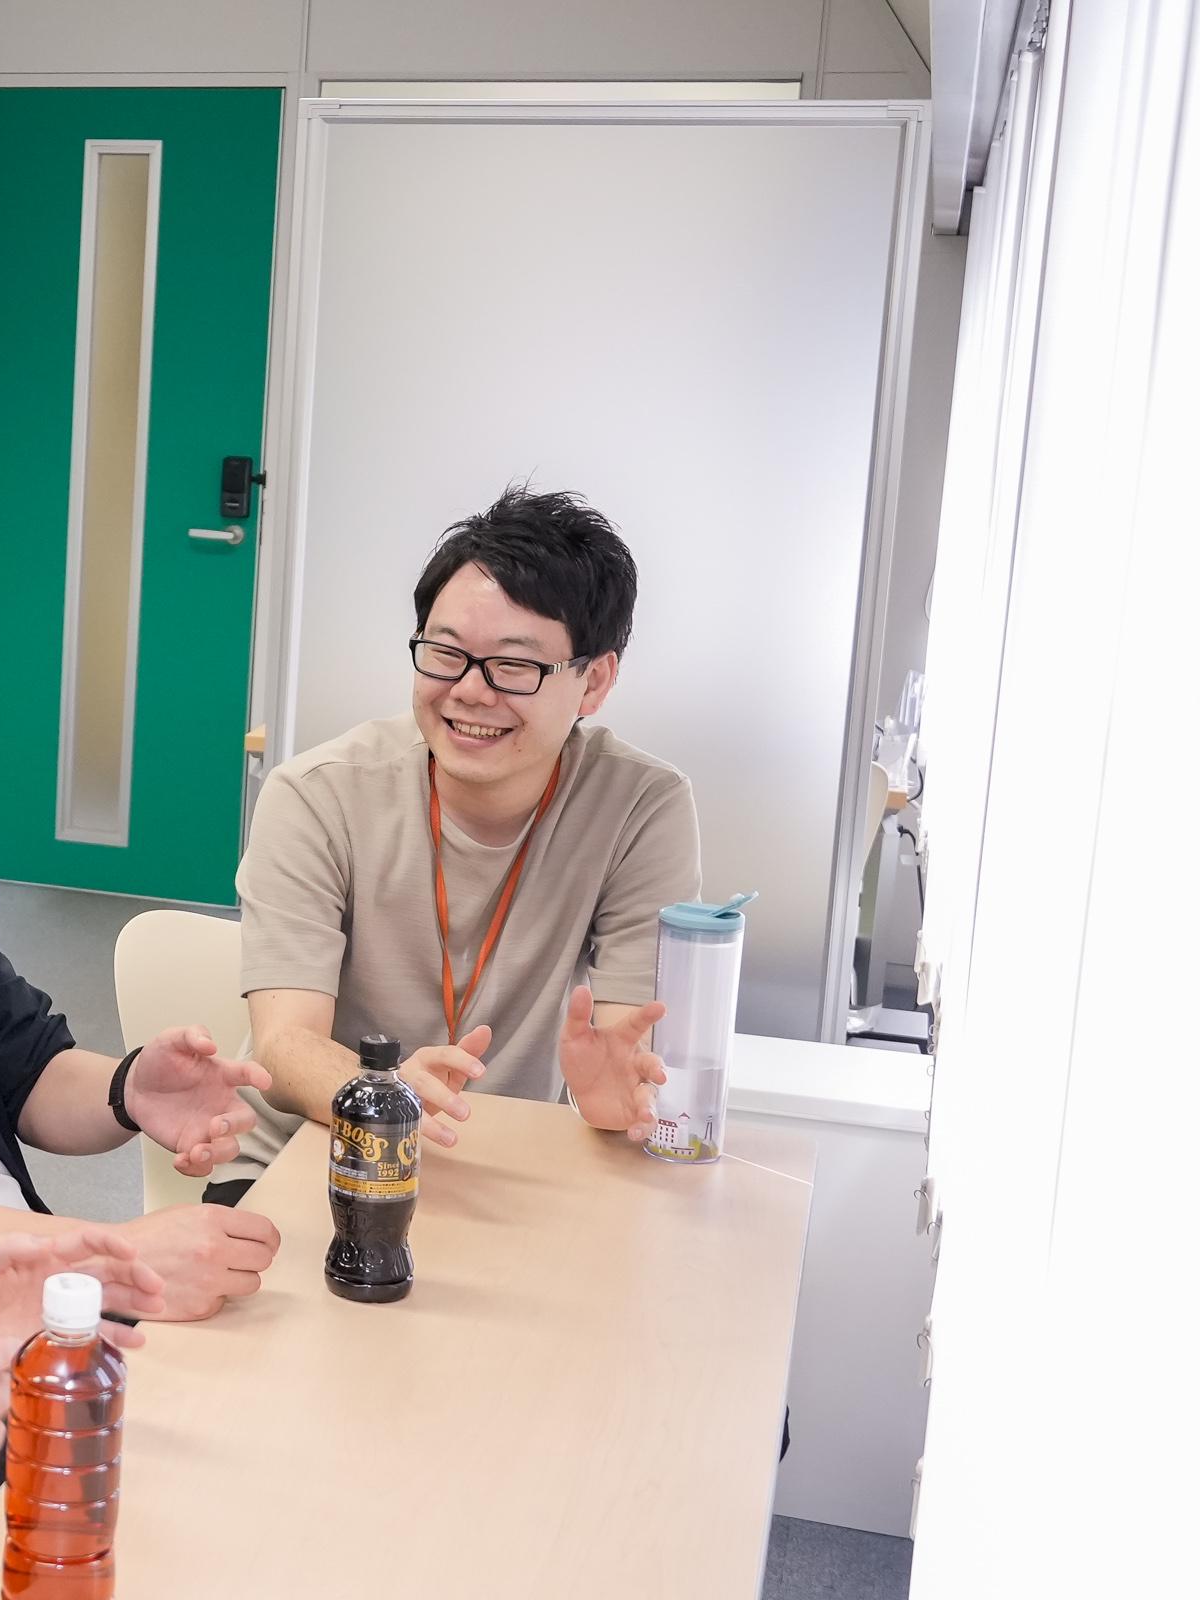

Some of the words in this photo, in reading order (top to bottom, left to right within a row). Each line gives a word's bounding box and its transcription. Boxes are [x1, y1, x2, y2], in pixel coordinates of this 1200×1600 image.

[342, 1120, 389, 1162] BOSS
[377, 1162, 400, 1170] Since
[377, 1168, 400, 1177] 1992
